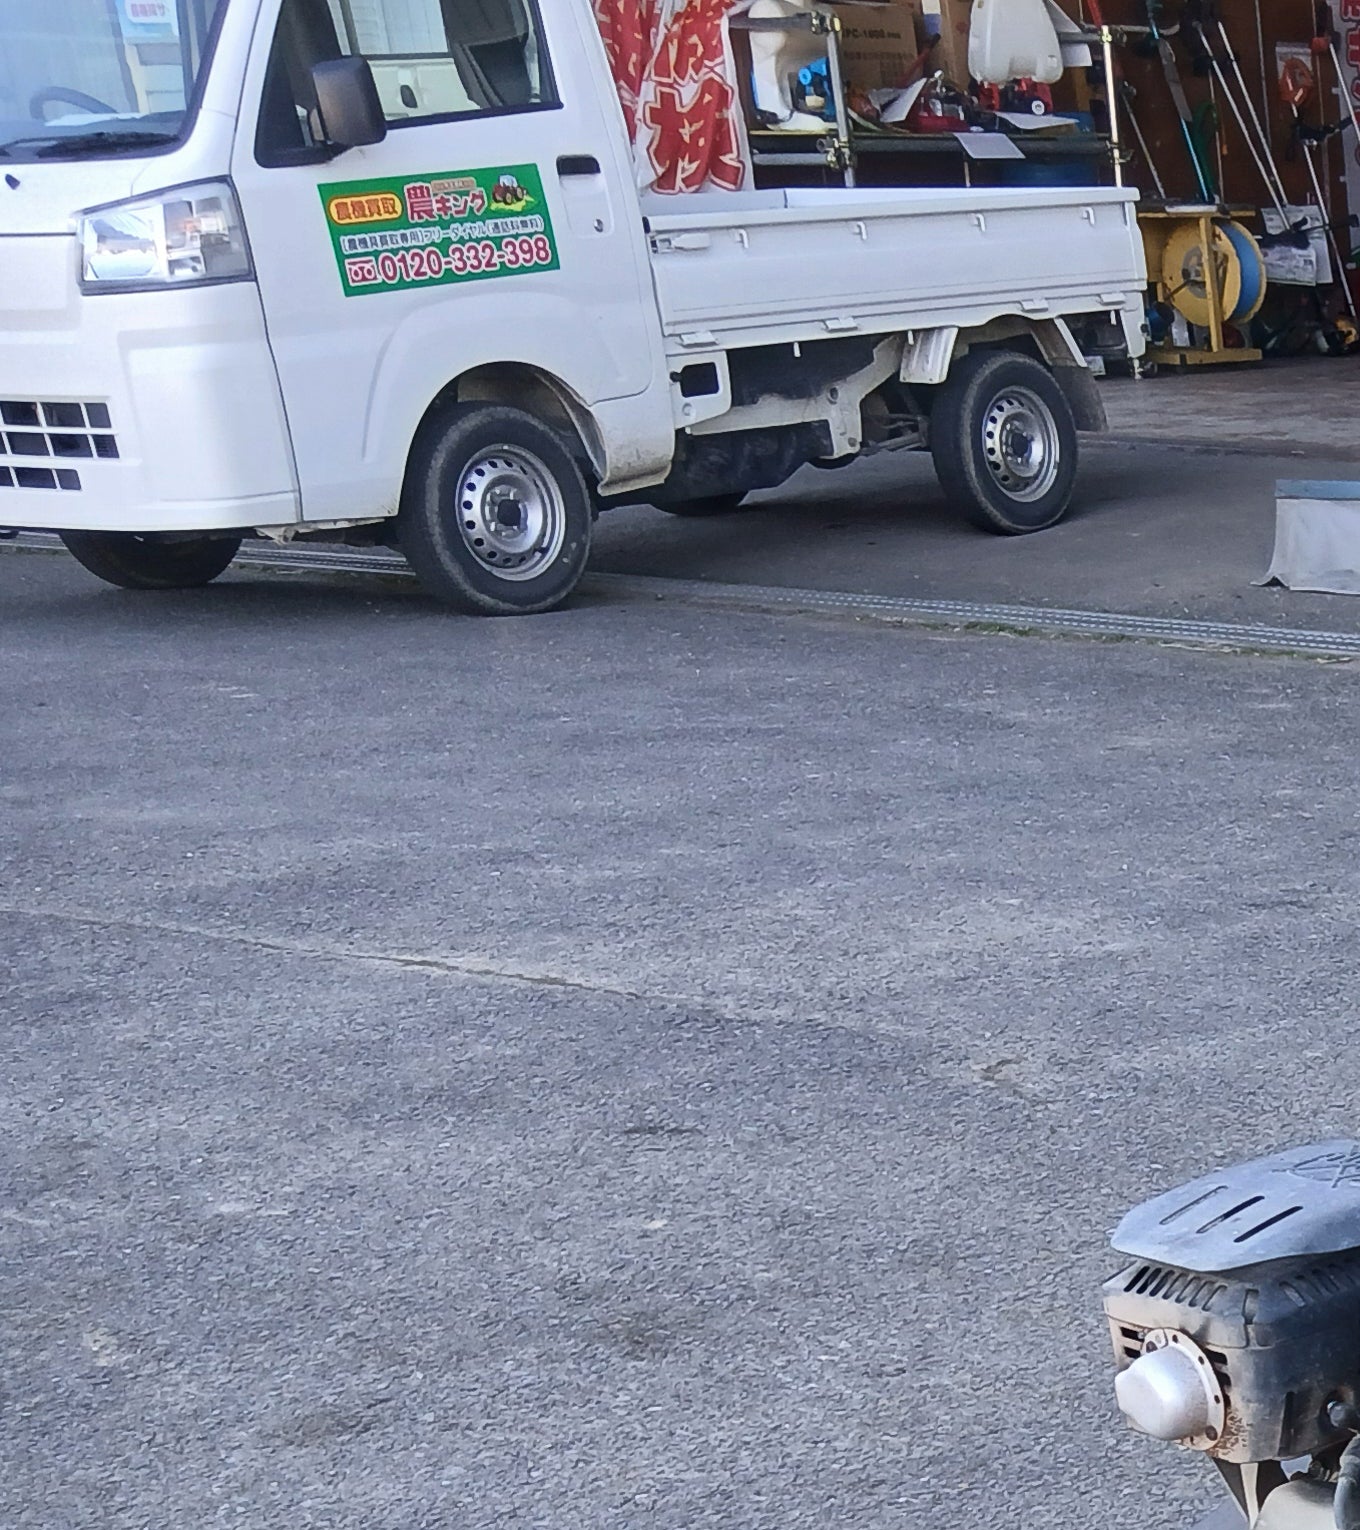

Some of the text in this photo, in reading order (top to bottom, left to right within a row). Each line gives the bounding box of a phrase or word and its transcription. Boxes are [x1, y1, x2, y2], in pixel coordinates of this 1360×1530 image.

[405, 183, 486, 221] 農キング
[379, 236, 550, 282] 0120-332-398
